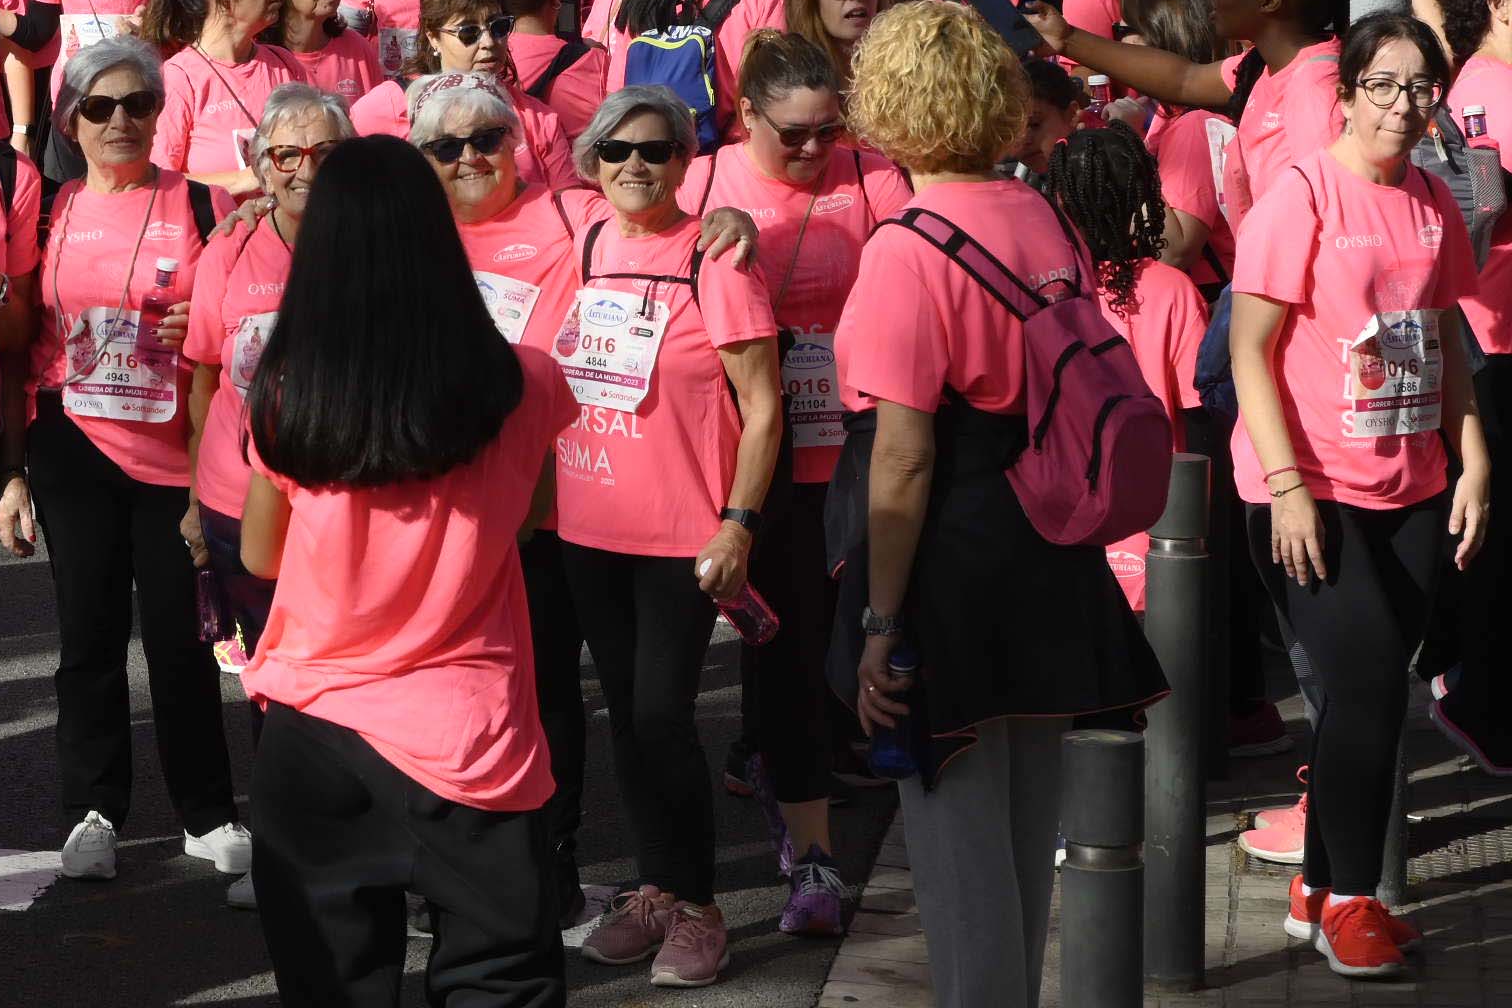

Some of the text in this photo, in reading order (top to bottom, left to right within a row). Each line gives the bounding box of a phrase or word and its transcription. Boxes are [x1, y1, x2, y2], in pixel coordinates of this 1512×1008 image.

[1335, 234, 1383, 250] OYSHO
[587, 310, 626, 323] ASTURIANA
[582, 337, 616, 353] 016
[99, 352, 138, 369] 016
[585, 356, 608, 368] 4844
[104, 371, 131, 384] 4943
[561, 368, 584, 377] ARRERA
[585, 369, 594, 378] DE
[596, 371, 602, 379] LA
[623, 376, 639, 384] 2023
[789, 378, 831, 394] 016
[794, 398, 827, 410] 21104
[557, 438, 613, 475] SUMA
